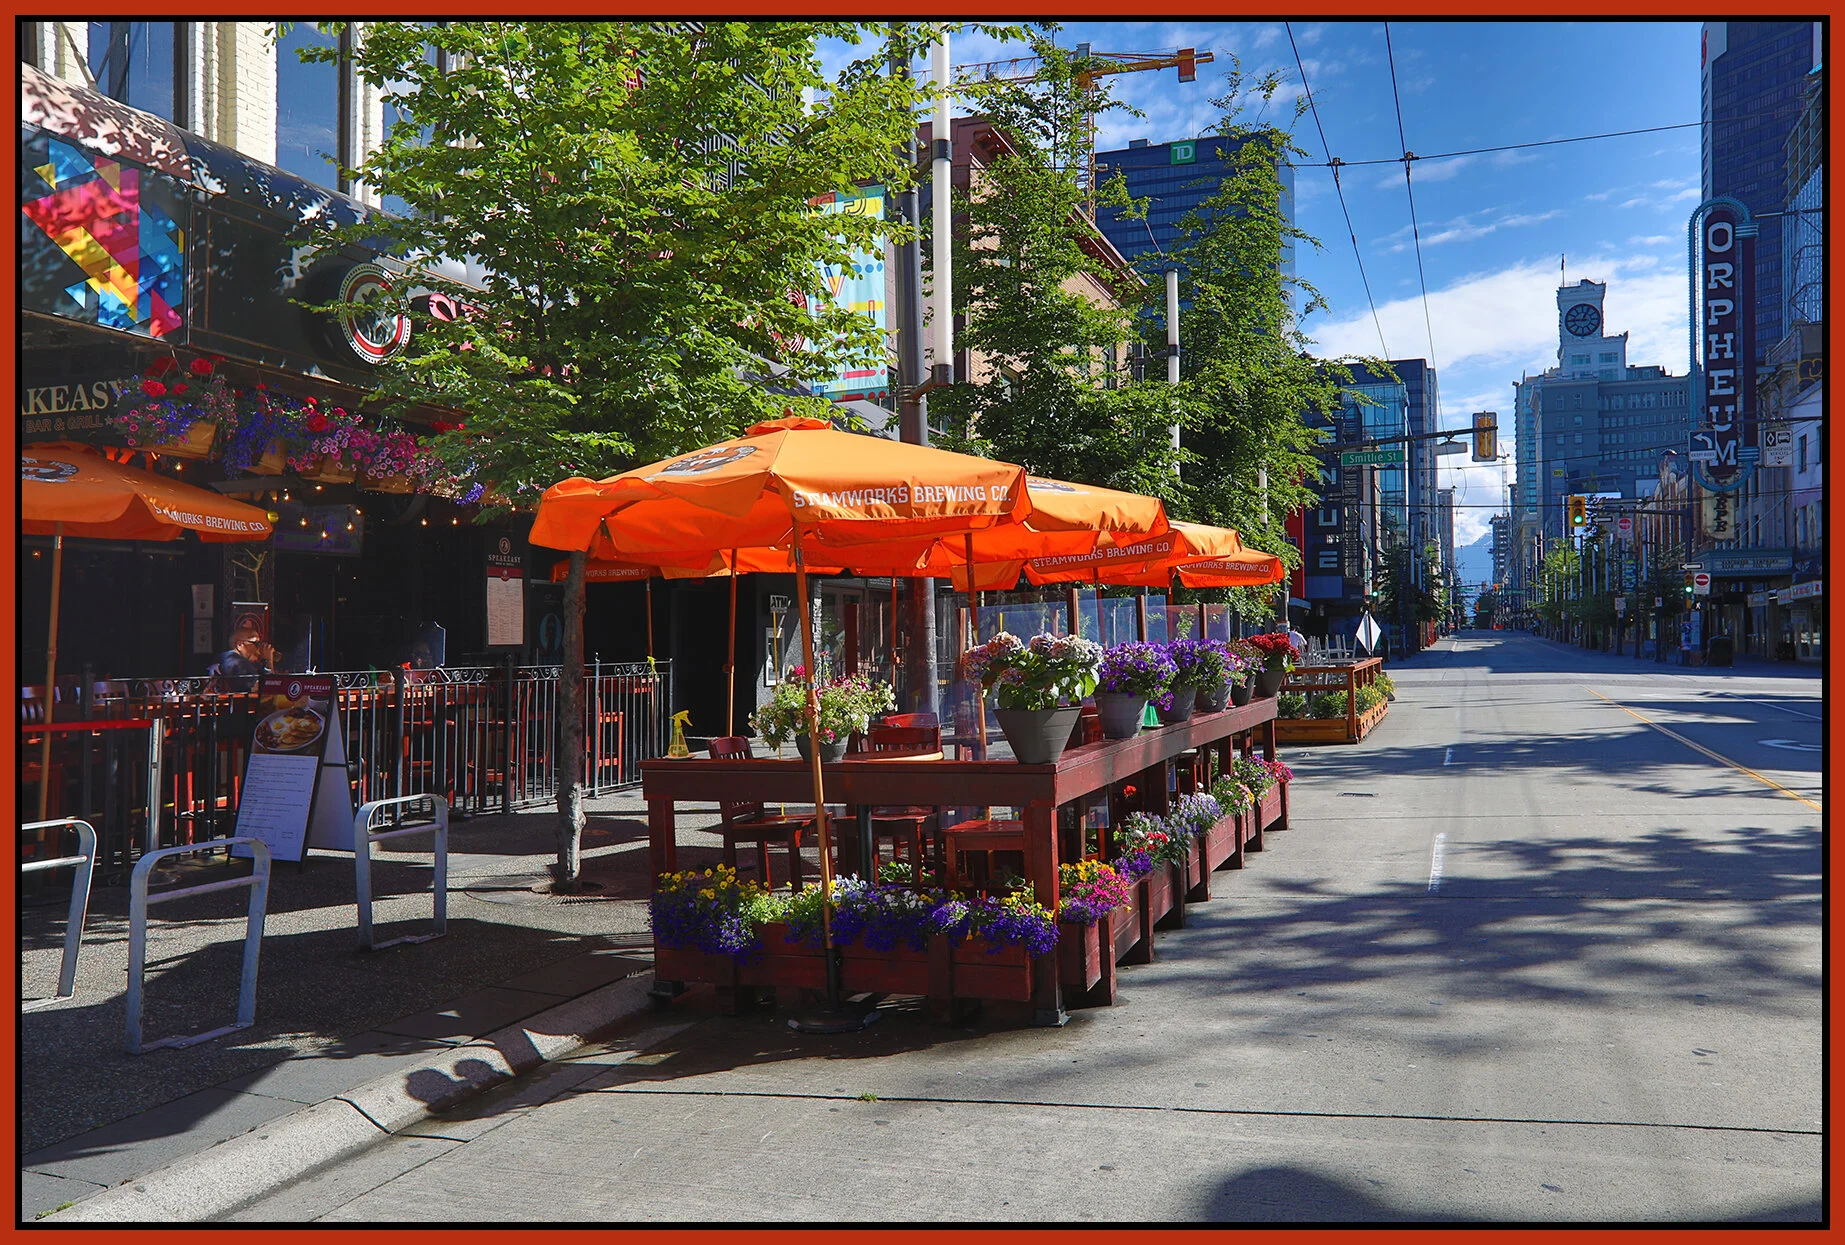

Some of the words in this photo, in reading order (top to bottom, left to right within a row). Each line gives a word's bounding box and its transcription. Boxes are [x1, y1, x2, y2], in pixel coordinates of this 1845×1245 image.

[1173, 145, 1193, 160] TD
[1708, 221, 1737, 467] ORPHEUM
[26, 419, 52, 433] BAR
[67, 414, 104, 429] GRILL
[1387, 452, 1397, 462] St
[793, 487, 909, 508] STEAMWORKS
[913, 486, 987, 503] BREWING
[991, 486, 1012, 502] CO.
[1317, 426, 1338, 568] ENUE
[206, 515, 248, 532] BREWING
[249, 521, 269, 532] CO.
[1106, 544, 1154, 559] BREWING
[1156, 541, 1172, 553] CO.
[608, 568, 640, 577] BREWING
[1225, 562, 1258, 572] BREWING
[1259, 563, 1271, 573] CO.
